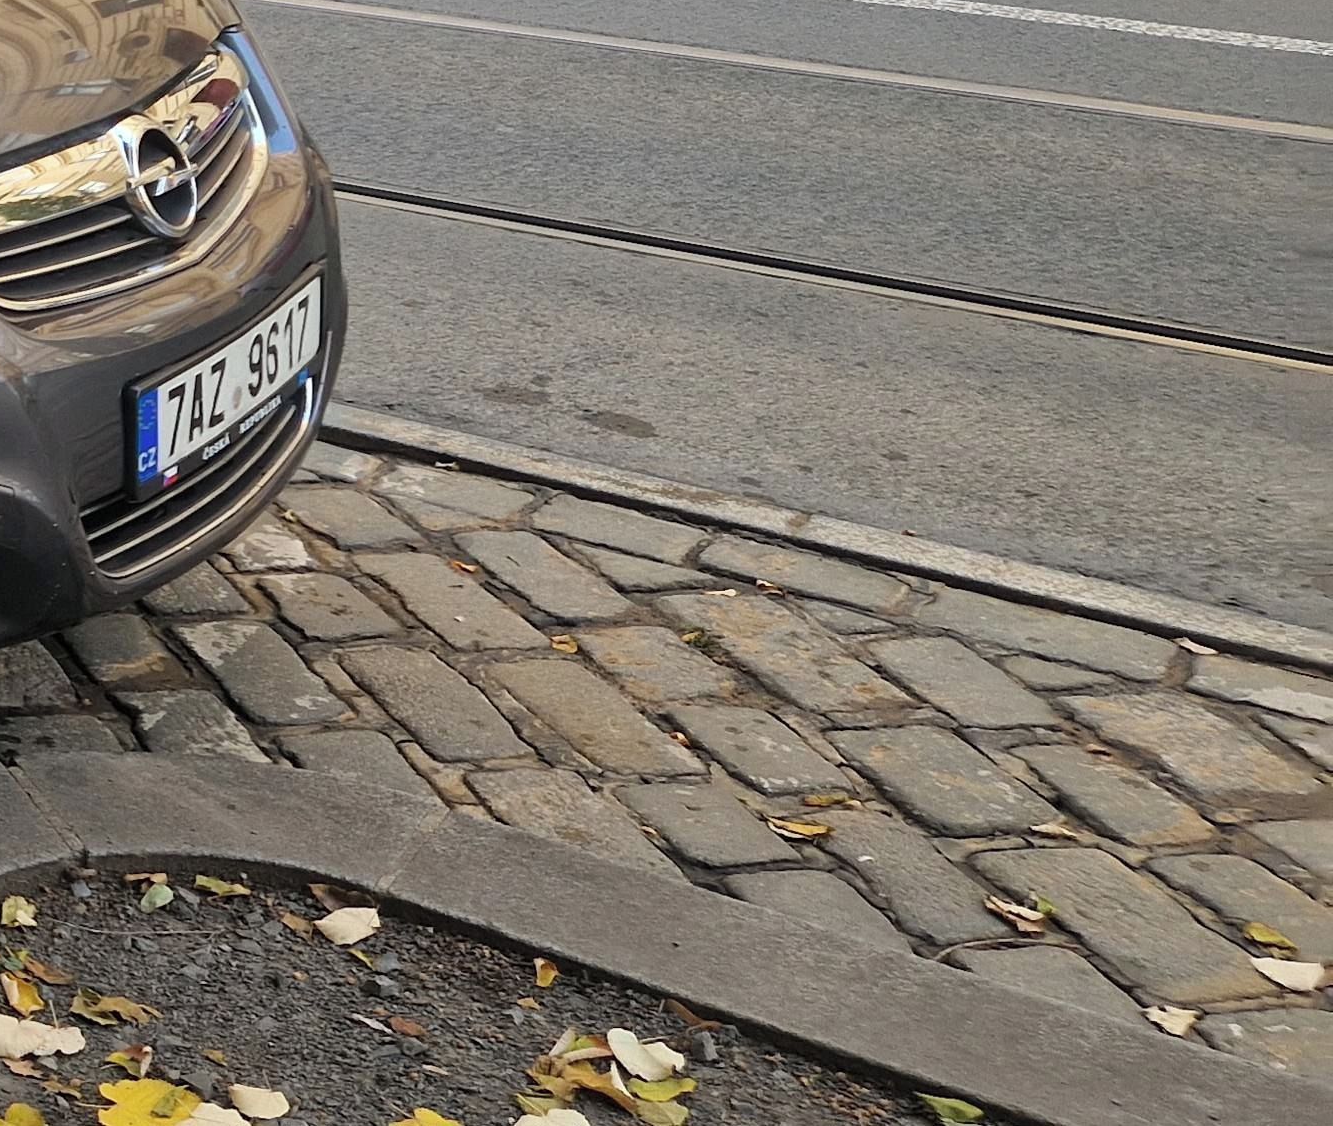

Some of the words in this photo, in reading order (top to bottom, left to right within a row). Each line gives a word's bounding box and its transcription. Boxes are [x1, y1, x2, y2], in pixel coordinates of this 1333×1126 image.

[167, 357, 227, 458] 7AZ
[248, 294, 310, 398] 9617
[138, 446, 157, 472] CZ
